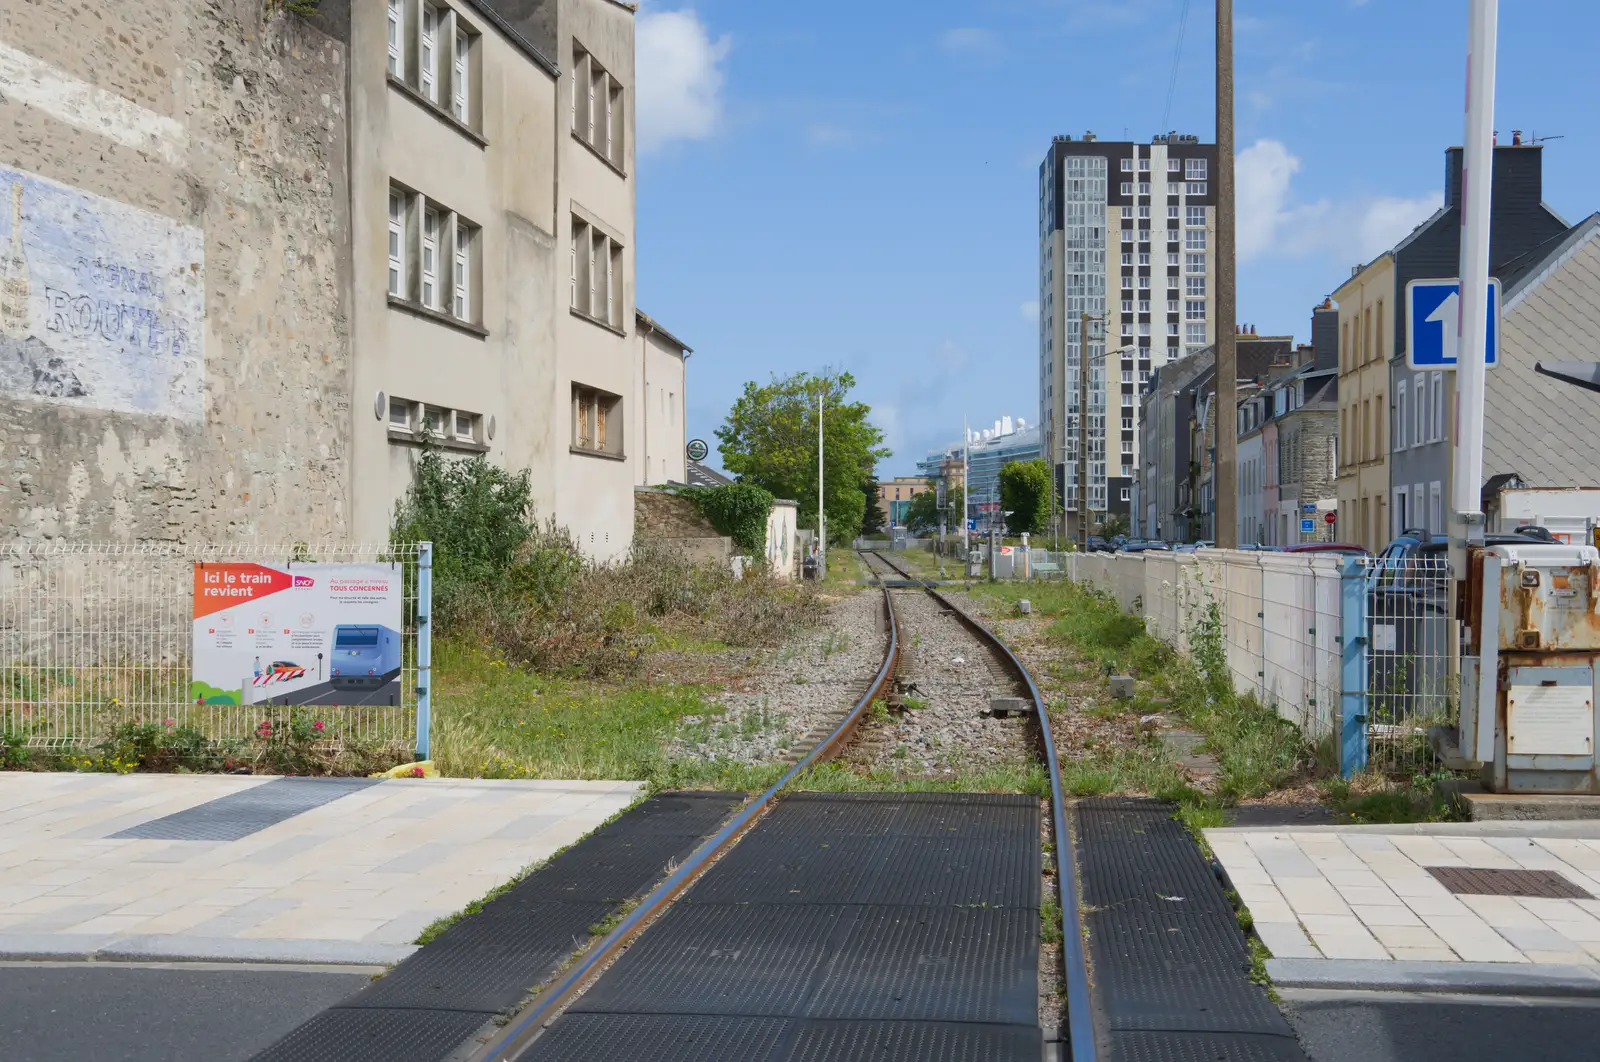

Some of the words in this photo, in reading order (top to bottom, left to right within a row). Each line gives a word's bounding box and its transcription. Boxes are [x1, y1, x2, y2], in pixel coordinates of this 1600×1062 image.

[204, 571, 220, 584] Ici
[223, 571, 236, 584] le
[240, 571, 272, 584] train
[204, 584, 254, 597] revient
